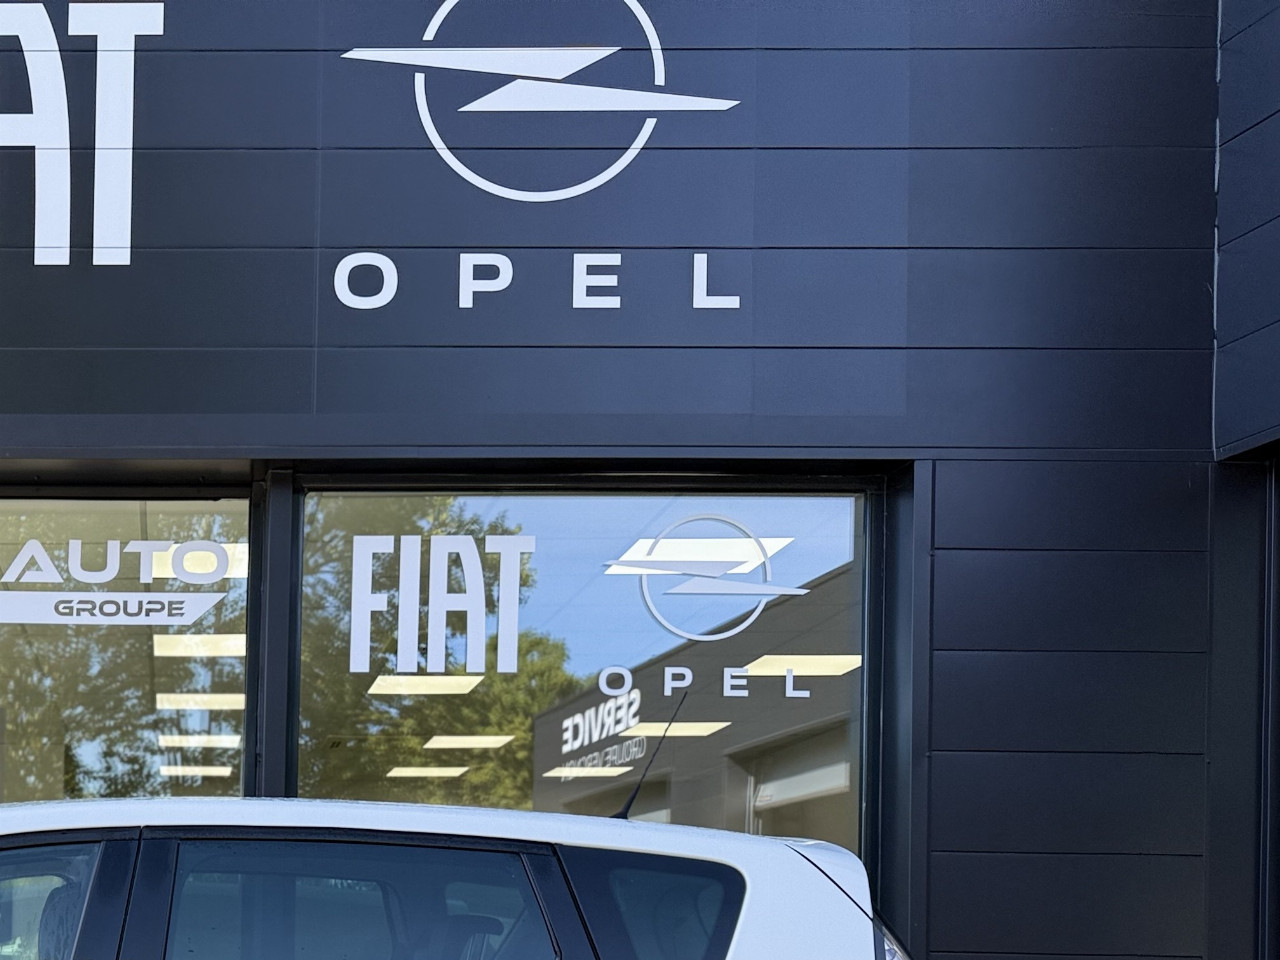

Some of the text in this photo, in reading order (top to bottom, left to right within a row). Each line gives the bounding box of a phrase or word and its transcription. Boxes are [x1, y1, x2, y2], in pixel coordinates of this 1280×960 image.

[333, 251, 741, 310] OPEL
[1, 538, 230, 585] AUTO
[54, 599, 186, 619] GROUPE
[349, 535, 536, 673] FIAT
[598, 665, 811, 699] OPEL
